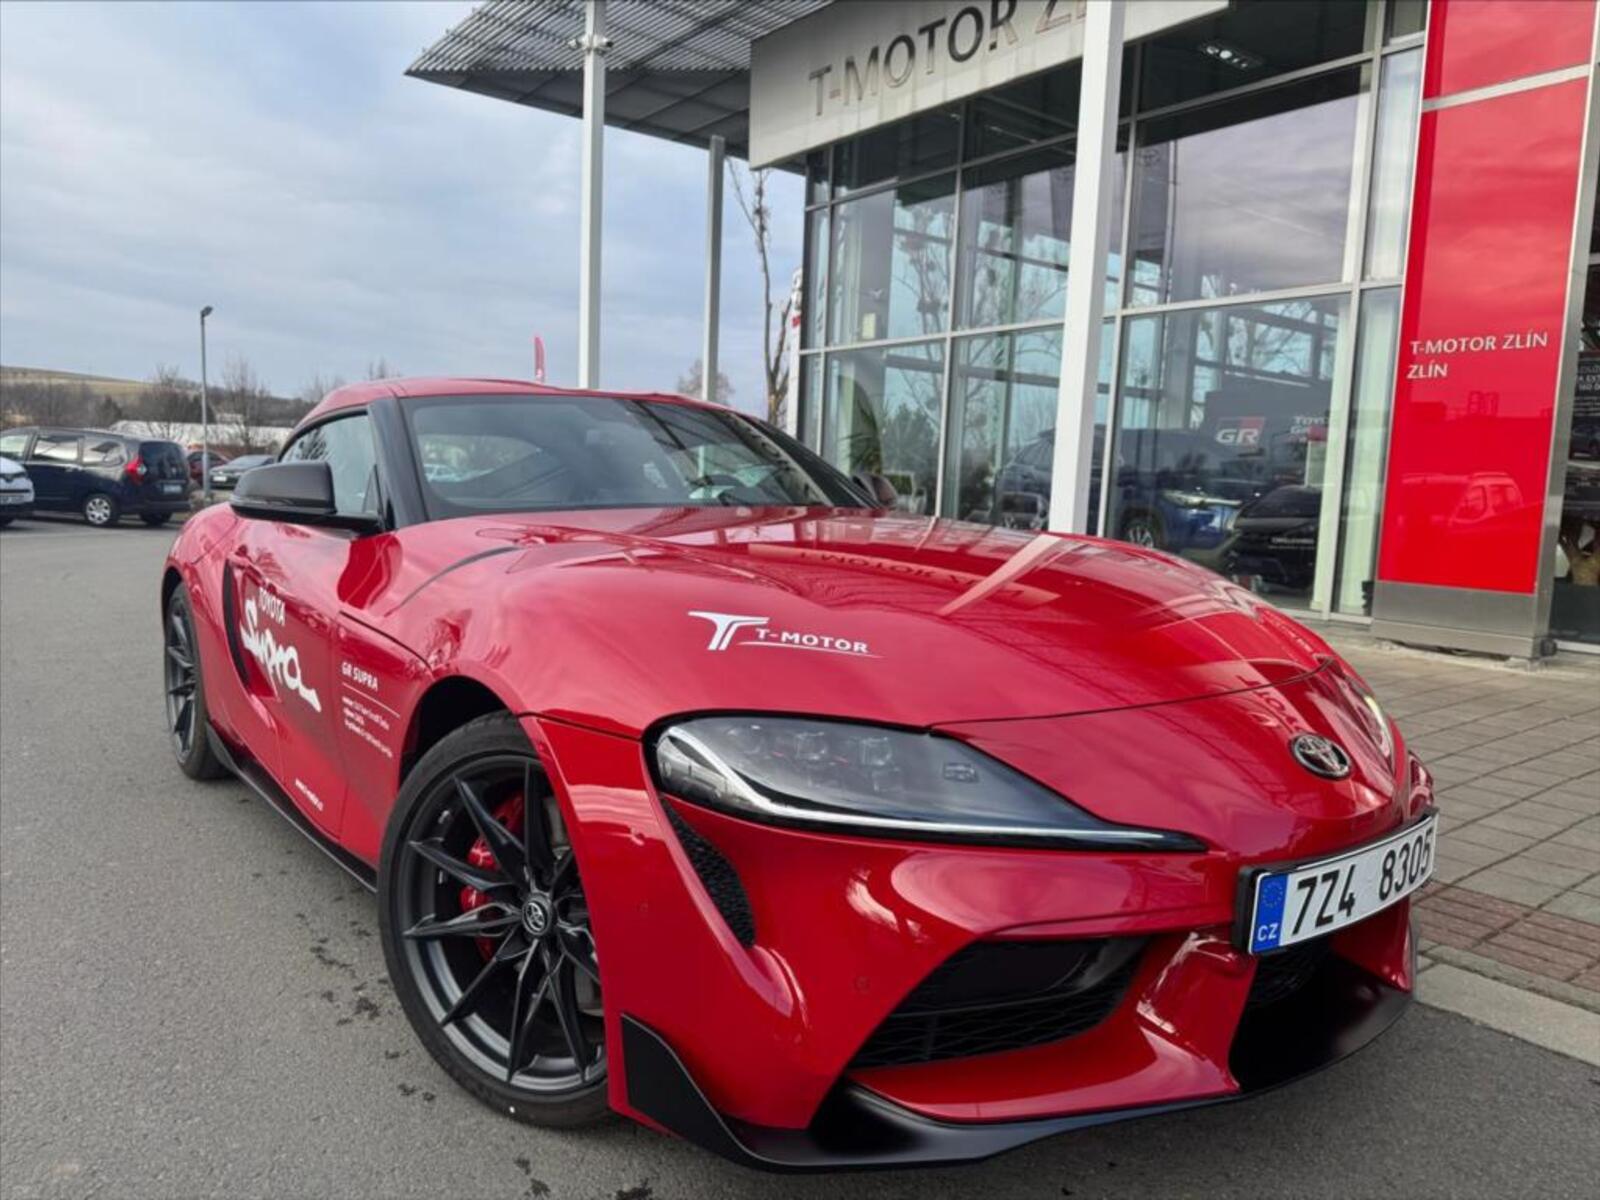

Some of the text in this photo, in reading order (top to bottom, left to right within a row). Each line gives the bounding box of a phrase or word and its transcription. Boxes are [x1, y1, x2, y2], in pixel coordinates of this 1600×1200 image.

[808, 0, 1020, 116] T-MOTOR
[1409, 329, 1549, 355] T-MOTOR ZLÍN
[1406, 360, 1448, 379] ZLÍN
[1216, 428, 1259, 444] GR
[755, 628, 868, 653] T-MOTOR
[353, 666, 379, 692] SUPRA
[1291, 827, 1434, 936] 7Z4 8305
[1257, 923, 1279, 942] CZ
